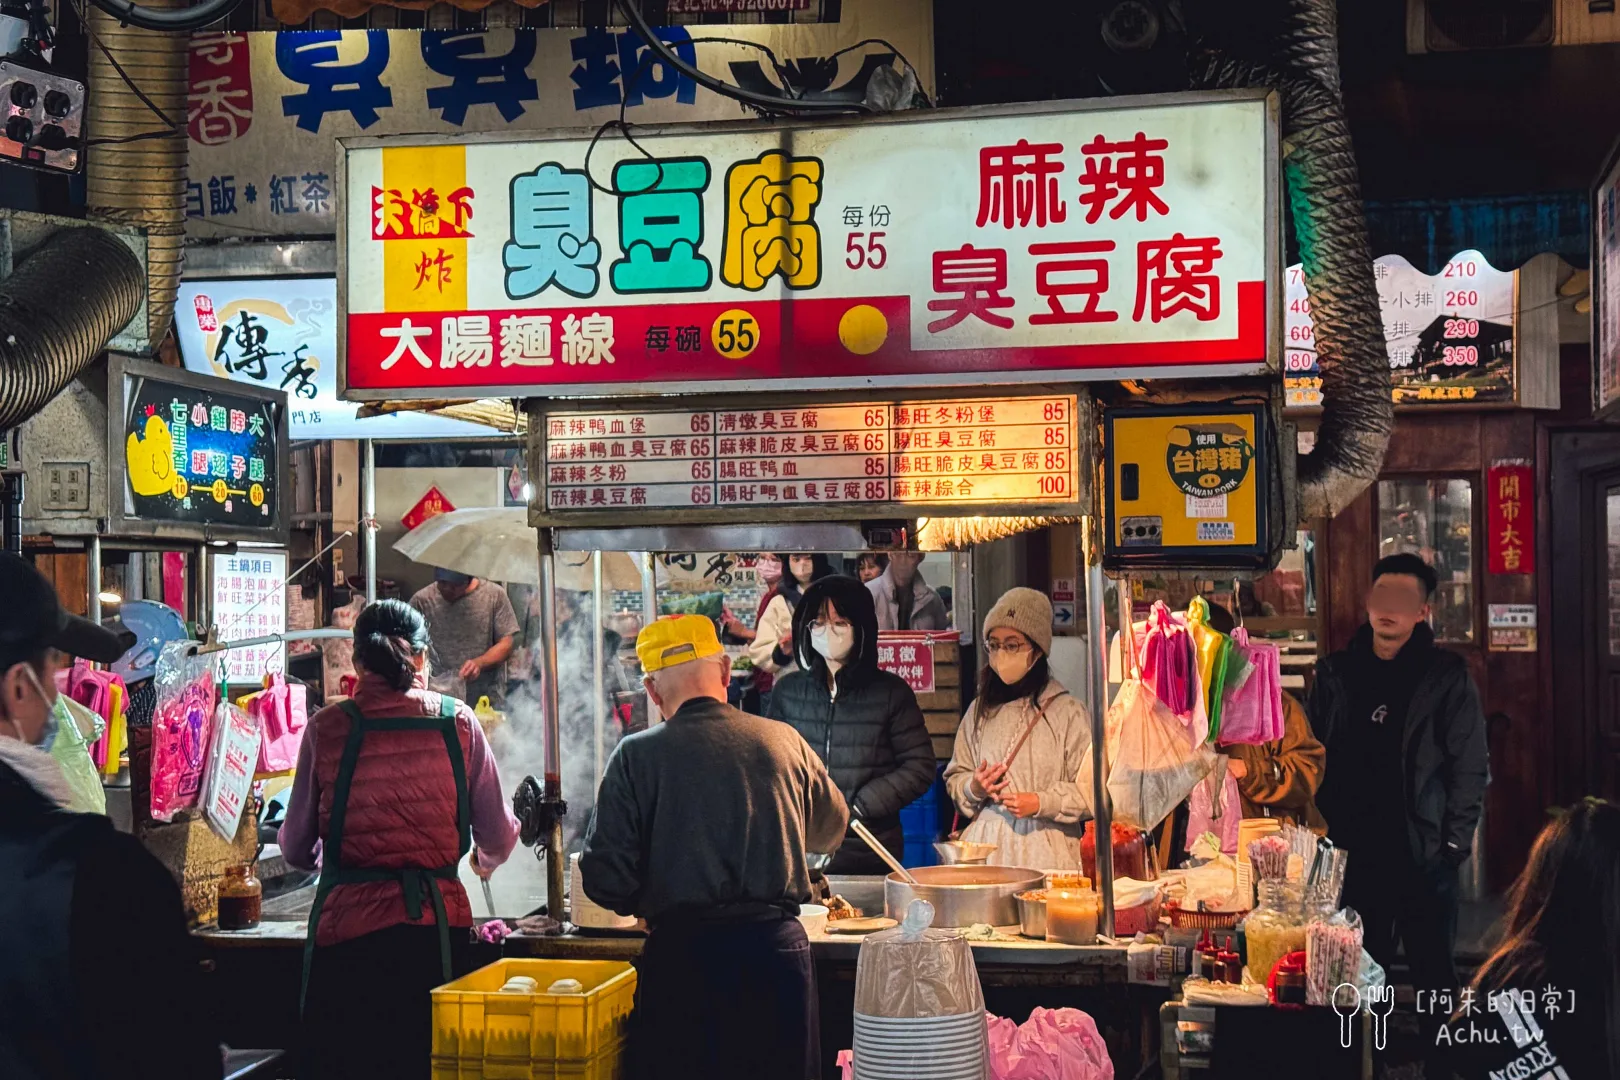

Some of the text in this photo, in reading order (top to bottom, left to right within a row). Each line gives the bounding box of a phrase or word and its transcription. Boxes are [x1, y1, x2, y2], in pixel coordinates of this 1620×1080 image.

[975, 131, 1171, 230] 麻辣
[268, 171, 331, 215] 紅茶
[502, 148, 824, 300] 臭豆腐
[842, 204, 891, 228] 每份
[845, 232, 888, 270] 55
[413, 247, 454, 294] 炸
[1444, 261, 1476, 278] 210
[927, 232, 1224, 334] 臭豆腐
[1446, 290, 1478, 306] 260
[645, 319, 755, 353] 每碗 55
[1290, 326, 1311, 341] 60
[1444, 319, 1479, 337] 290
[380, 312, 616, 370] 大腸麵線
[1443, 347, 1478, 364] 350
[550, 414, 710, 436] 麻辣鴨血堡 65
[719, 409, 884, 431] 清燉臭豆腐 65
[893, 402, 1064, 426] 腸旺冬粉堡 85
[550, 438, 710, 460] 麻辣鴨血臭豆腐 65
[719, 433, 884, 455] 麻辣脆皮臭豆腐 65
[893, 427, 1064, 450] 腸旺臭豆腐 85
[1196, 434, 1216, 445] 使用
[864, 457, 885, 476] 85
[893, 451, 1065, 474] 腸旺脆皮臭豆腐 85
[1172, 447, 1242, 474] 台灣豬
[550, 461, 711, 483] 麻辣冬粉 65
[691, 485, 712, 504] 65
[864, 481, 885, 500] 85
[893, 475, 1065, 498] 麻辣綜合 100
[1181, 478, 1238, 496] TAIWAN PORK
[1499, 475, 1523, 571] 開市大吉
[879, 665, 924, 679] 伙伴
